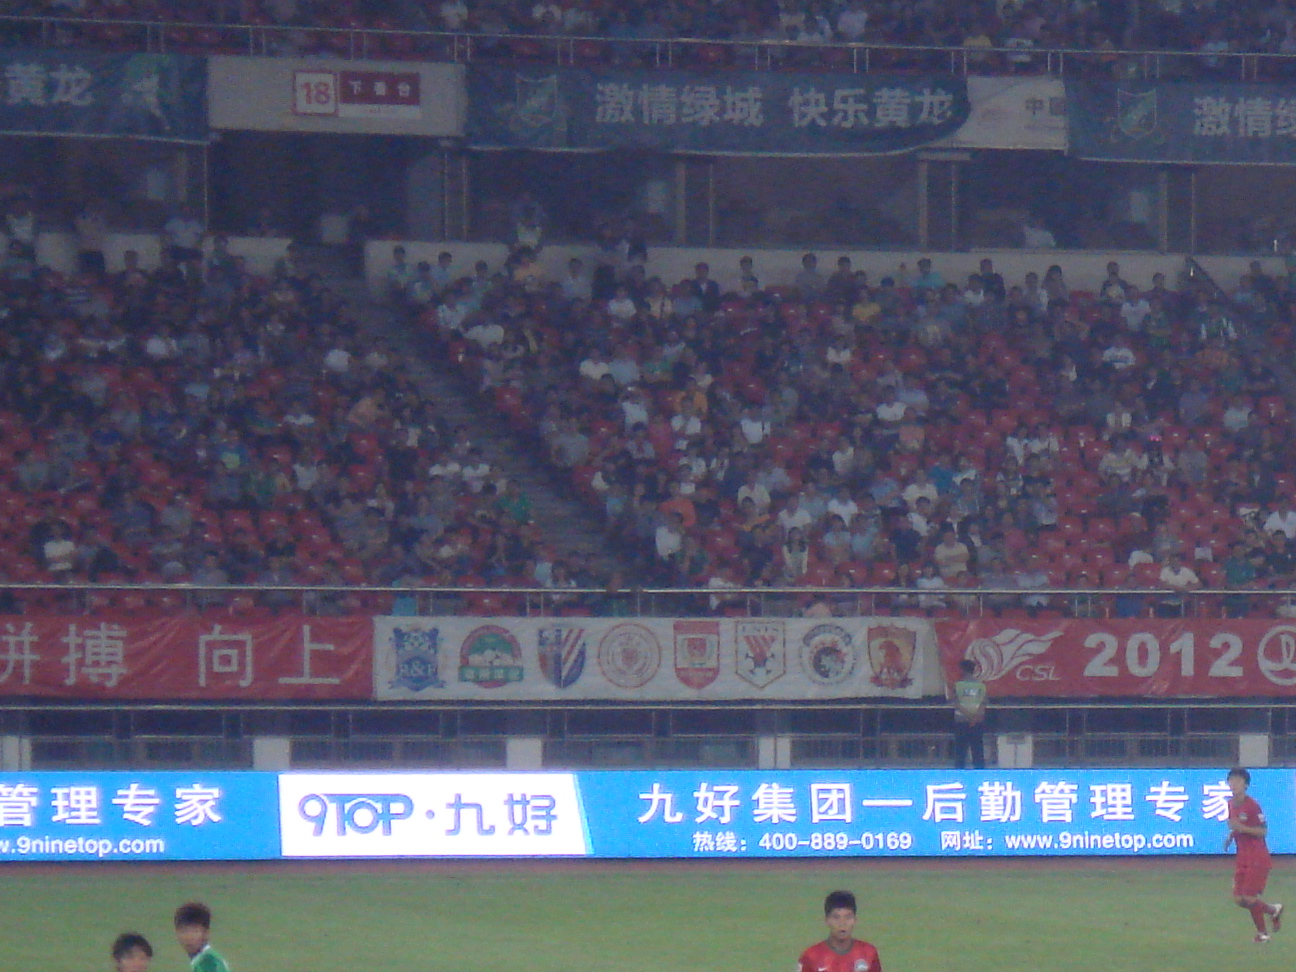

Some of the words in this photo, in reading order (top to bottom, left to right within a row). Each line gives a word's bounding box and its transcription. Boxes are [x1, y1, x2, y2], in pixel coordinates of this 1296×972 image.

[301, 81, 331, 105] 18
[596, 82, 764, 128] 激情绿城
[790, 87, 955, 130] 快乐黄龙
[200, 624, 341, 687] 向上
[1015, 663, 1062, 682] CSL
[1083, 632, 1245, 678] 2012
[0, 783, 222, 827] 管理专家
